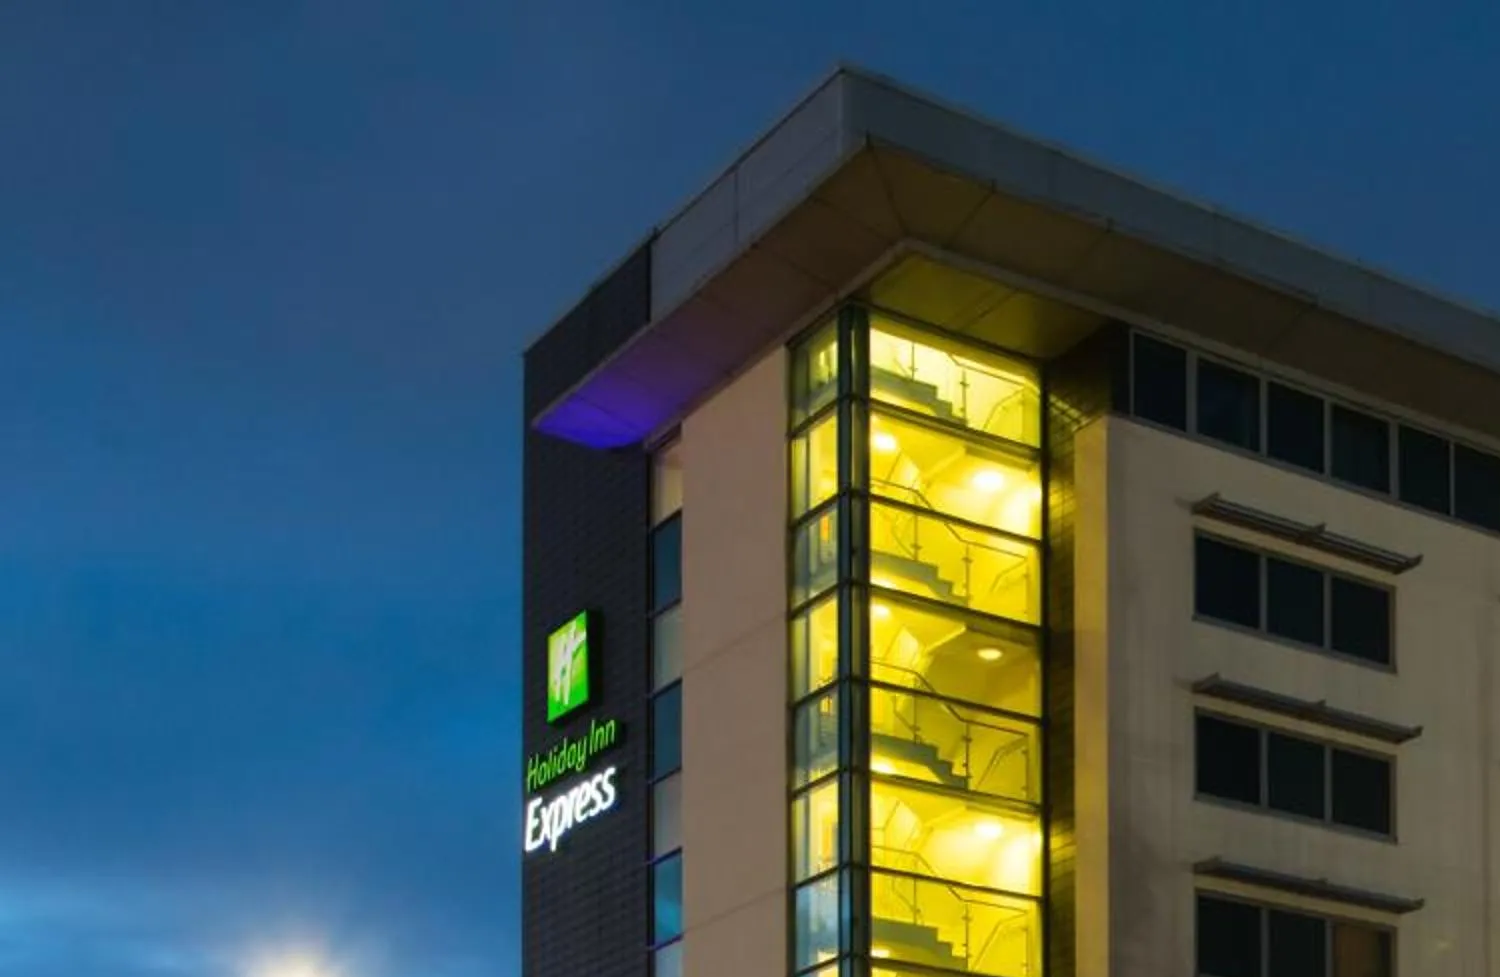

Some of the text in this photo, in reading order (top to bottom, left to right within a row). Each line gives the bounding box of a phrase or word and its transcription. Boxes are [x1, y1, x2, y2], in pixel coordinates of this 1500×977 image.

[526, 718, 617, 794] Holiday Inn
[524, 766, 618, 853] Express
